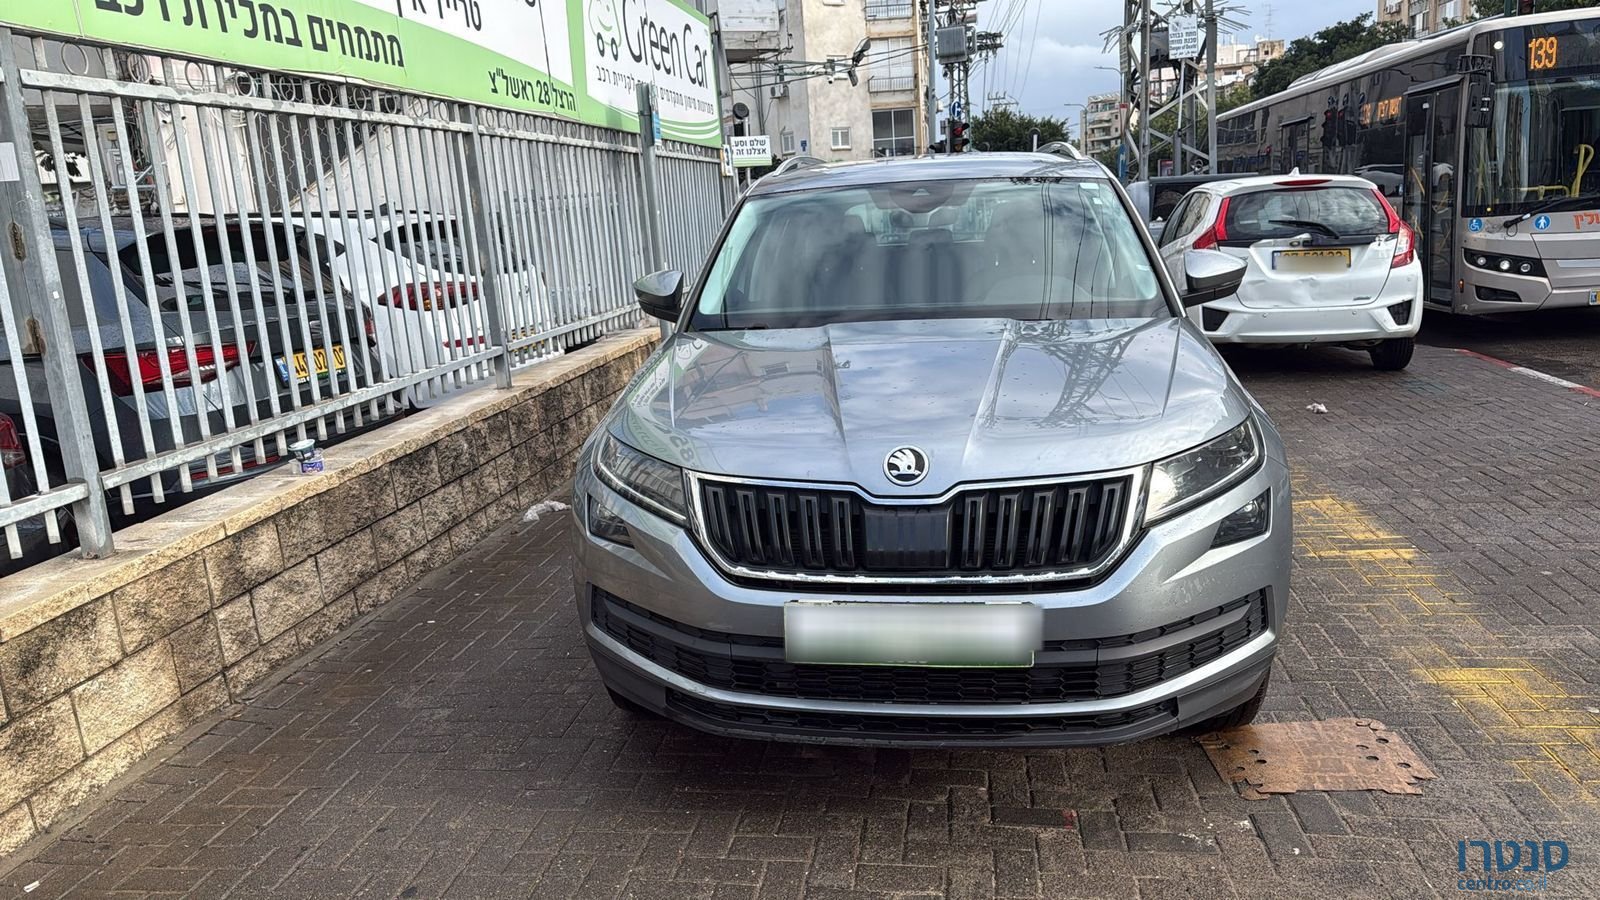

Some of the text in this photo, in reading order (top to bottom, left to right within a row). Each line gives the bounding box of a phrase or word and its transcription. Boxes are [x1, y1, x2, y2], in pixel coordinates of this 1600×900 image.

[307, 14, 405, 67] מתמחים
[622, 0, 708, 89] Green Car
[1528, 36, 1558, 70] 139
[596, 65, 612, 84] רכב
[536, 80, 551, 106] 28
[551, 82, 577, 112] הרצל
[746, 147, 767, 155] אצלנו
[750, 138, 766, 146] שלם
